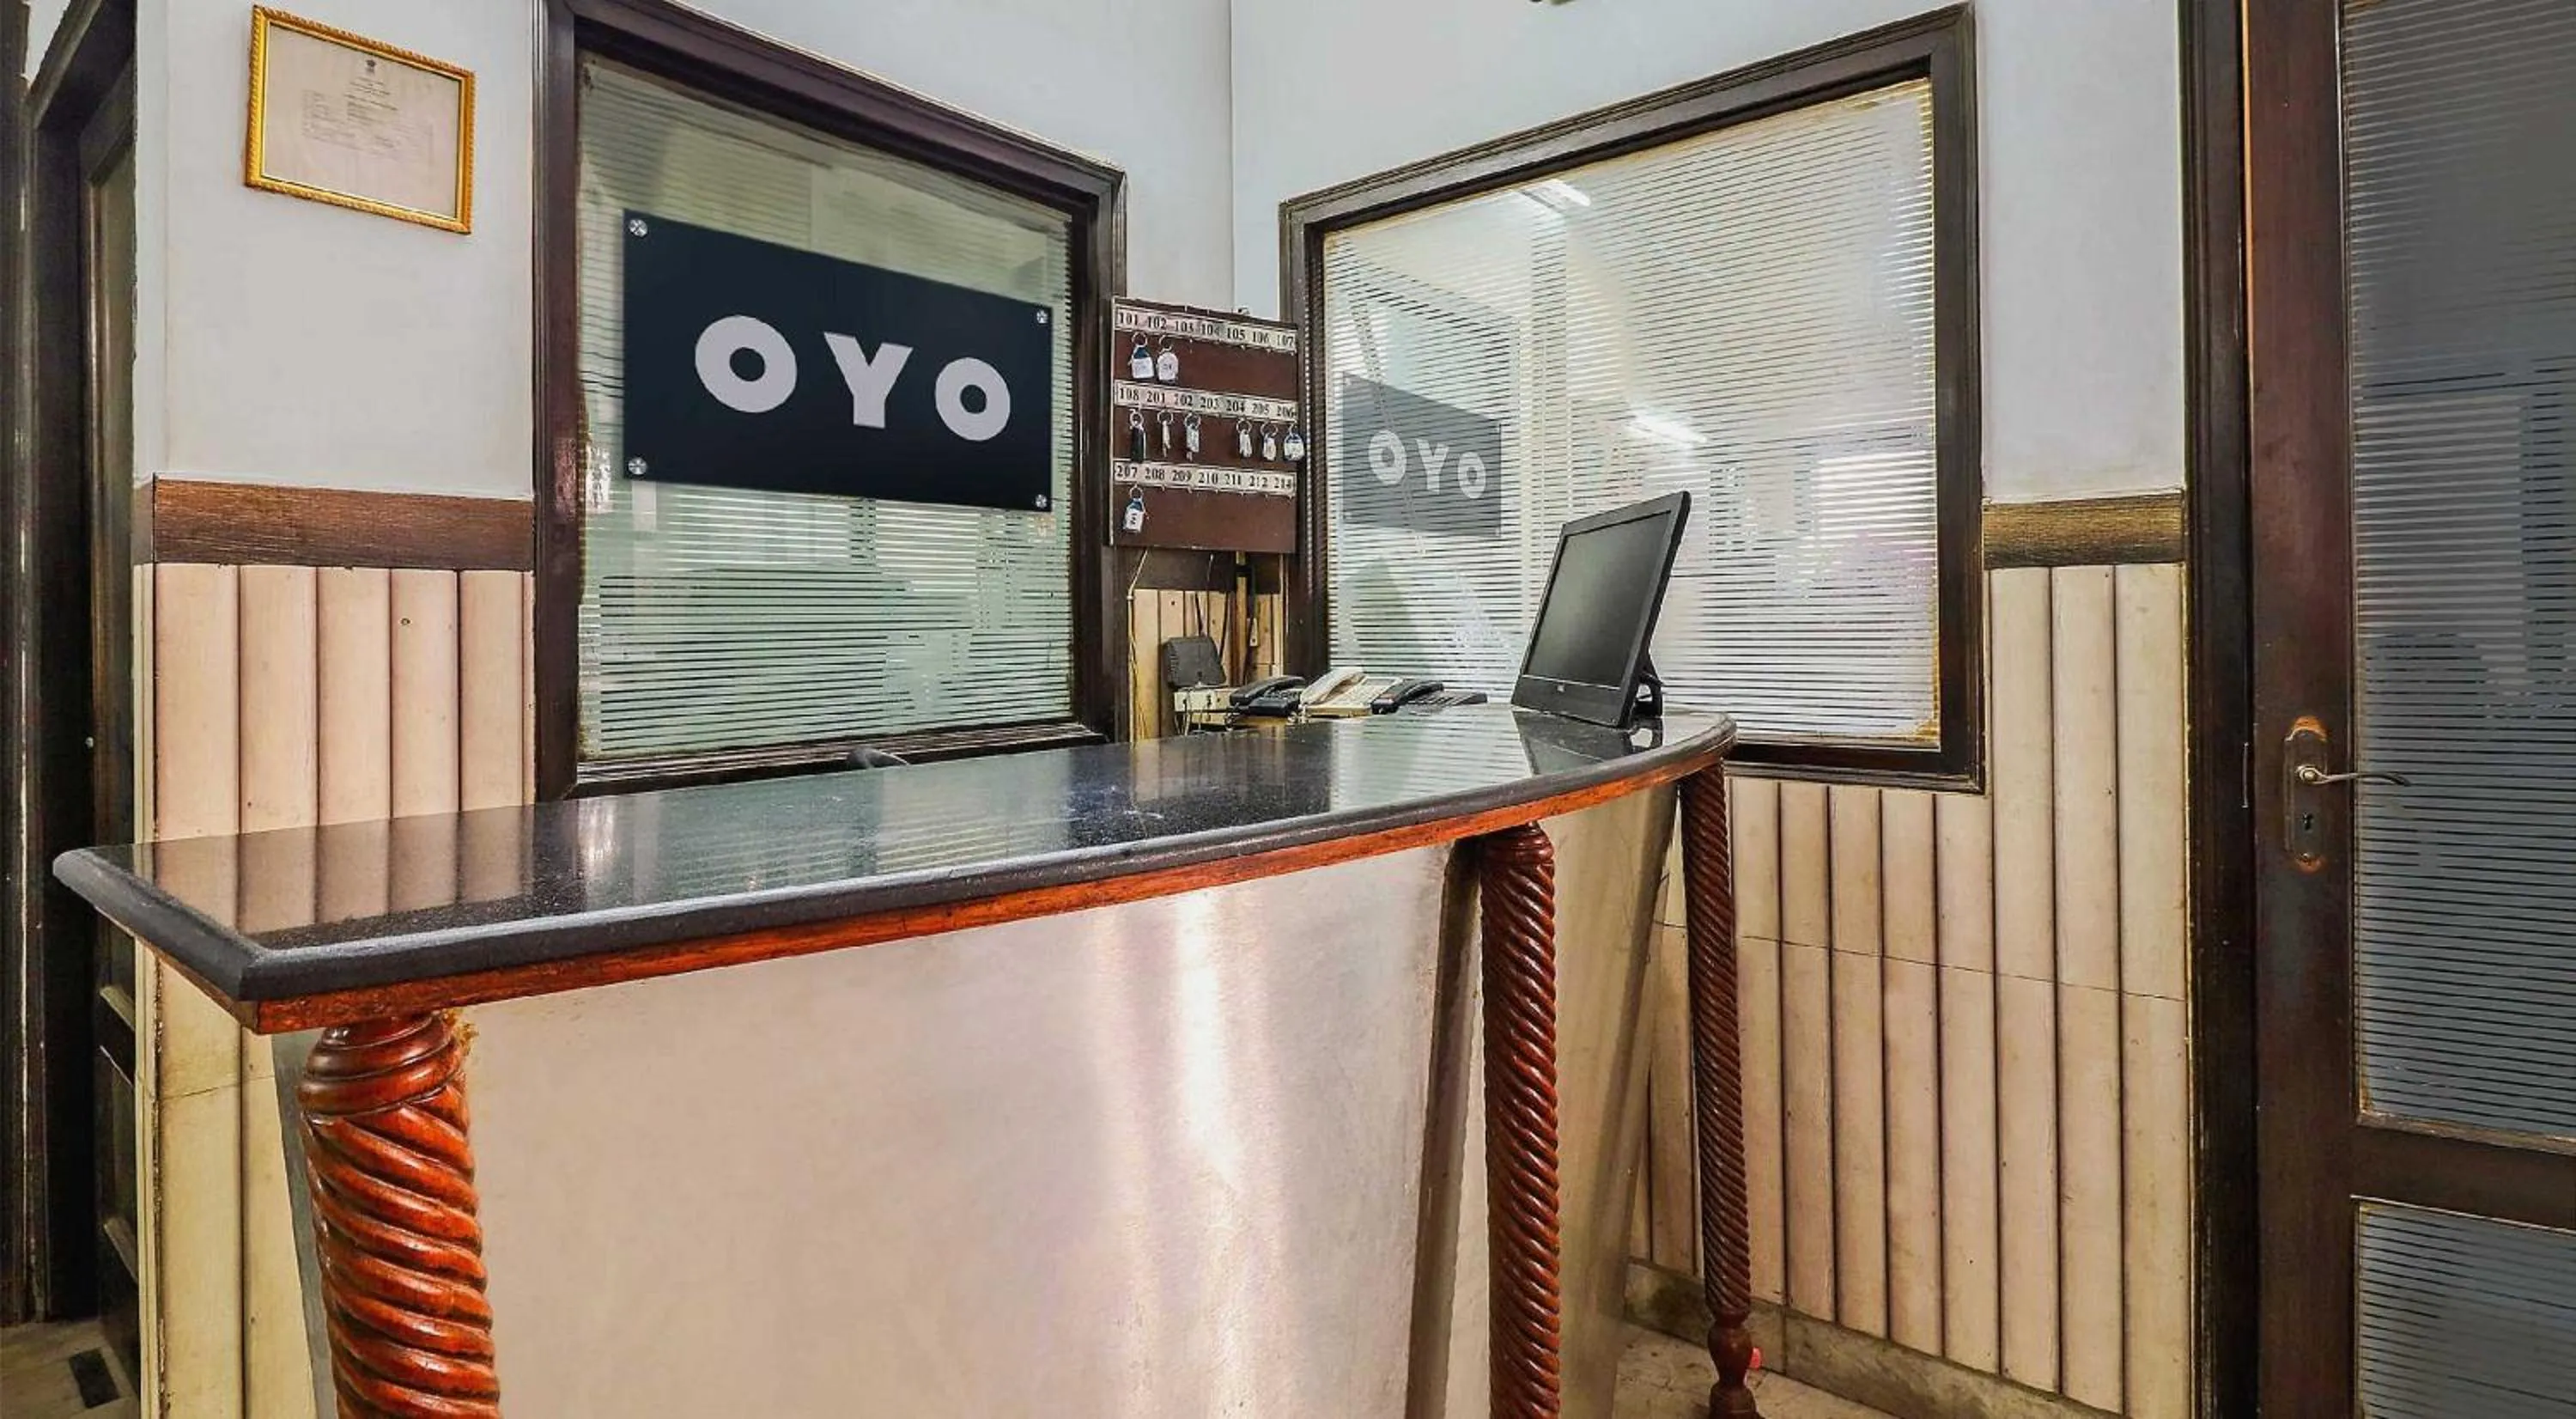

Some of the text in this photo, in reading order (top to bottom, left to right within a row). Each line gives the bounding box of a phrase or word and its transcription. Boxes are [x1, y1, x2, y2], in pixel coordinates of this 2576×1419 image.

[1119, 312, 1138, 326] 101
[1147, 315, 1167, 330] 102
[1227, 327, 1245, 340] 105
[1253, 332, 1269, 344] 106
[1277, 334, 1294, 347] 107
[695, 314, 1011, 441] OYO
[1120, 387, 1139, 401] 108
[1147, 391, 1165, 404] 201
[1174, 393, 1193, 406] 202
[1200, 397, 1220, 410] 203
[1226, 399, 1245, 412] 204
[1116, 465, 1138, 478] 207
[1145, 467, 1165, 480] 208
[1172, 470, 1192, 482] 209
[1199, 472, 1218, 484] 210
[1224, 473, 1241, 486] 211
[1249, 475, 1268, 488] 212
